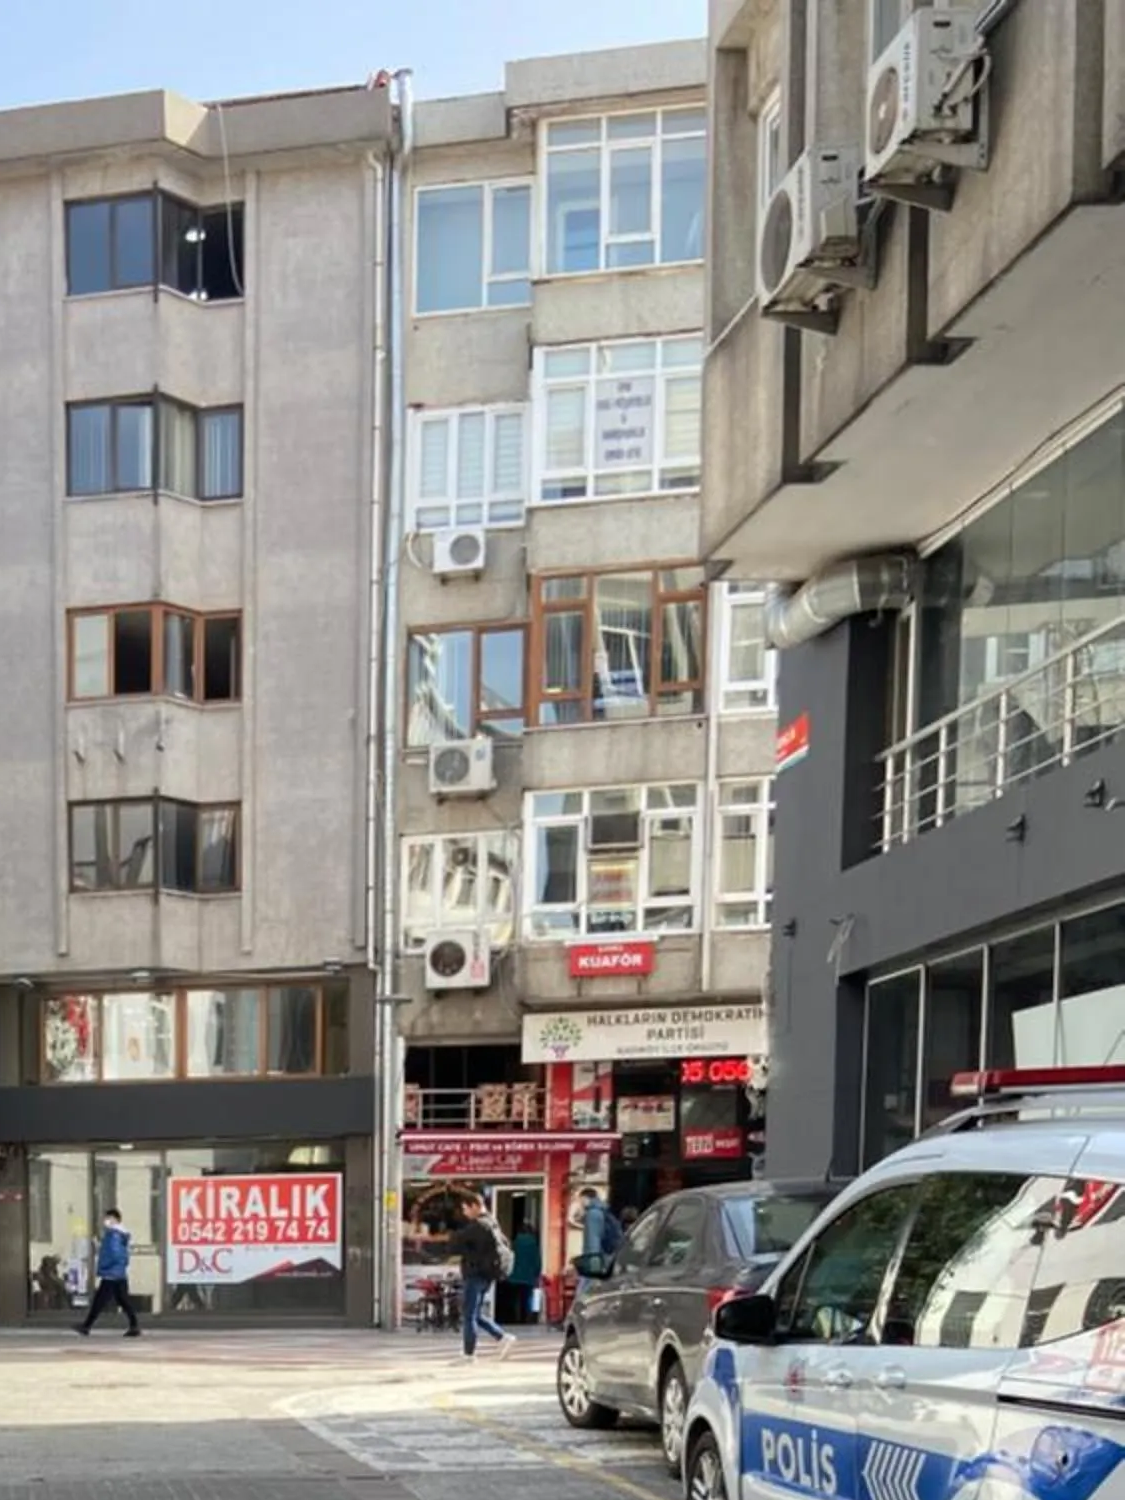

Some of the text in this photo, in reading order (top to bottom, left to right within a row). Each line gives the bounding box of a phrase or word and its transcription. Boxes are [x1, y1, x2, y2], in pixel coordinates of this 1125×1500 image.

[586, 1011, 667, 1027] HALKLARIN
[646, 1025, 705, 1041] PARTİSİ
[179, 1180, 330, 1220] KİRALIK
[178, 1219, 330, 1241] 0542 219 74 74
[761, 1427, 837, 1496] POLİS
